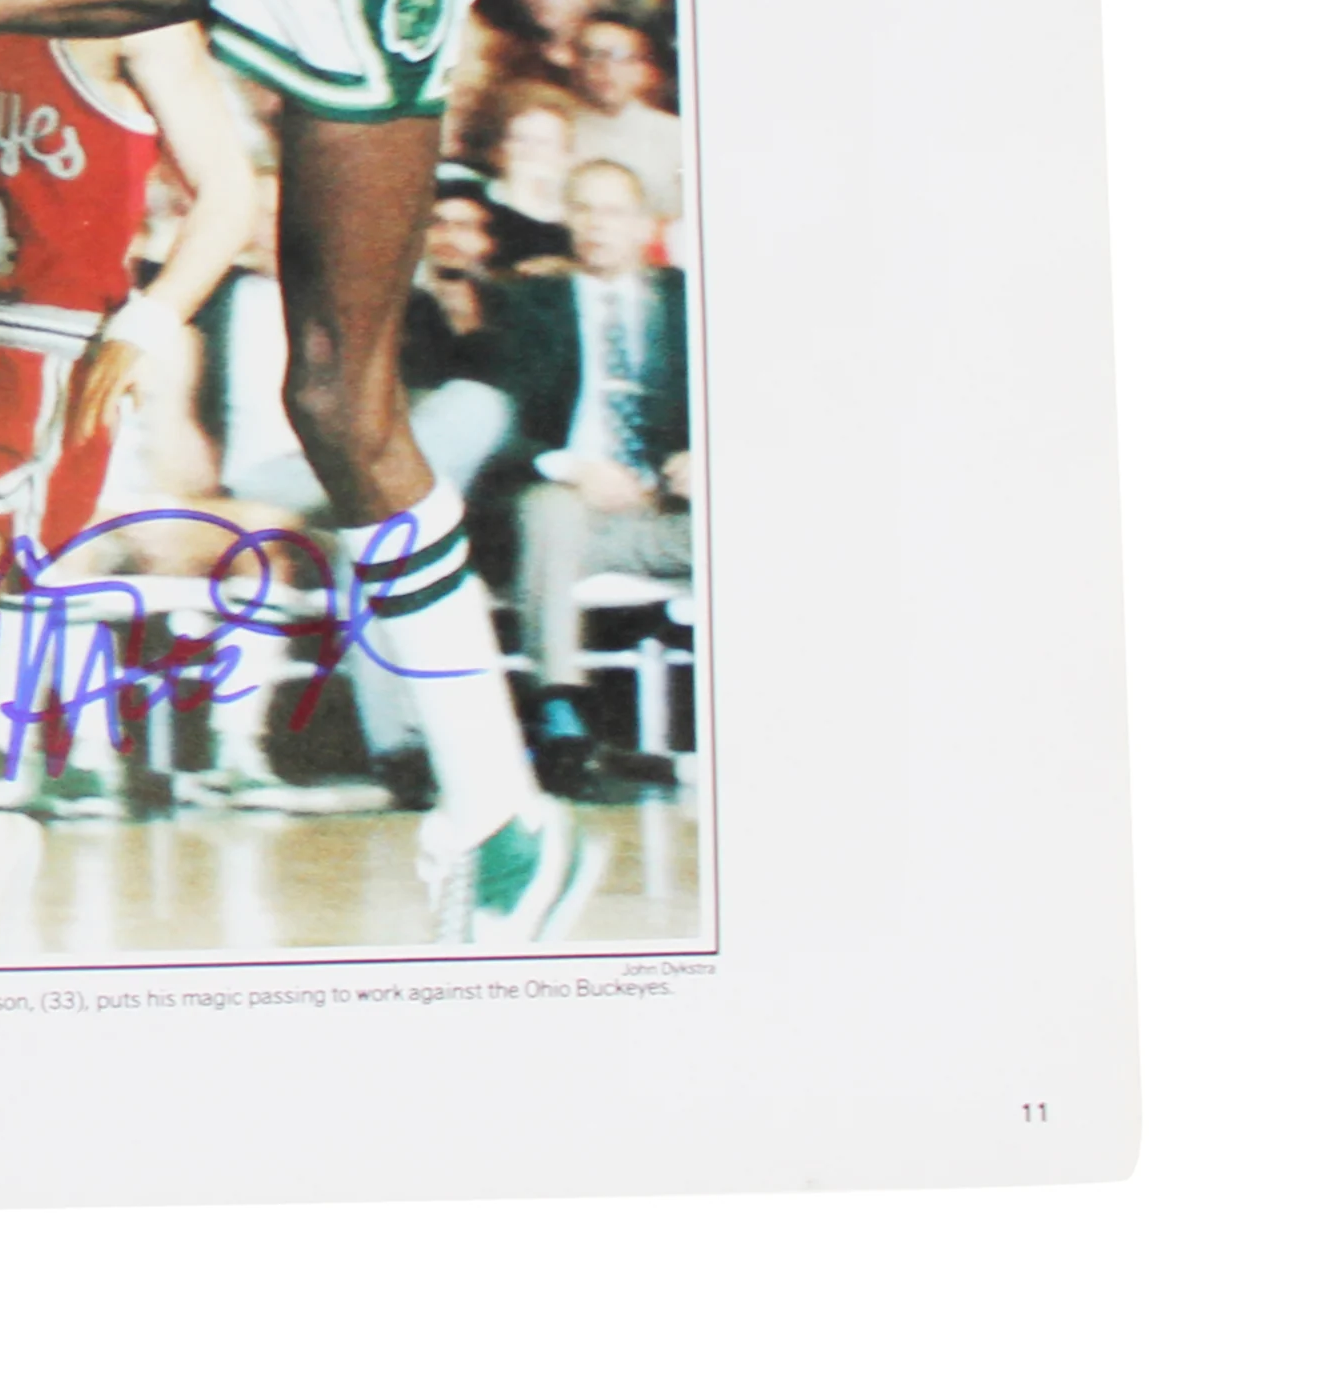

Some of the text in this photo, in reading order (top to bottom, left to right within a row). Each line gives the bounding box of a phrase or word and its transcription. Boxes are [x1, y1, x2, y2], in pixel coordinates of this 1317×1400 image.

[39, 989, 90, 1014] (33),
[95, 992, 142, 1013] puts
[146, 990, 178, 1008] his
[181, 991, 244, 1012] magic
[248, 989, 327, 1009] passing
[330, 987, 352, 1004] to
[354, 984, 405, 1003] work
[407, 985, 484, 1006] against
[486, 981, 520, 1000] the
[523, 978, 572, 999] Ohio
[575, 978, 675, 999] Buckeyes.
[1021, 1102, 1047, 1123] 11
